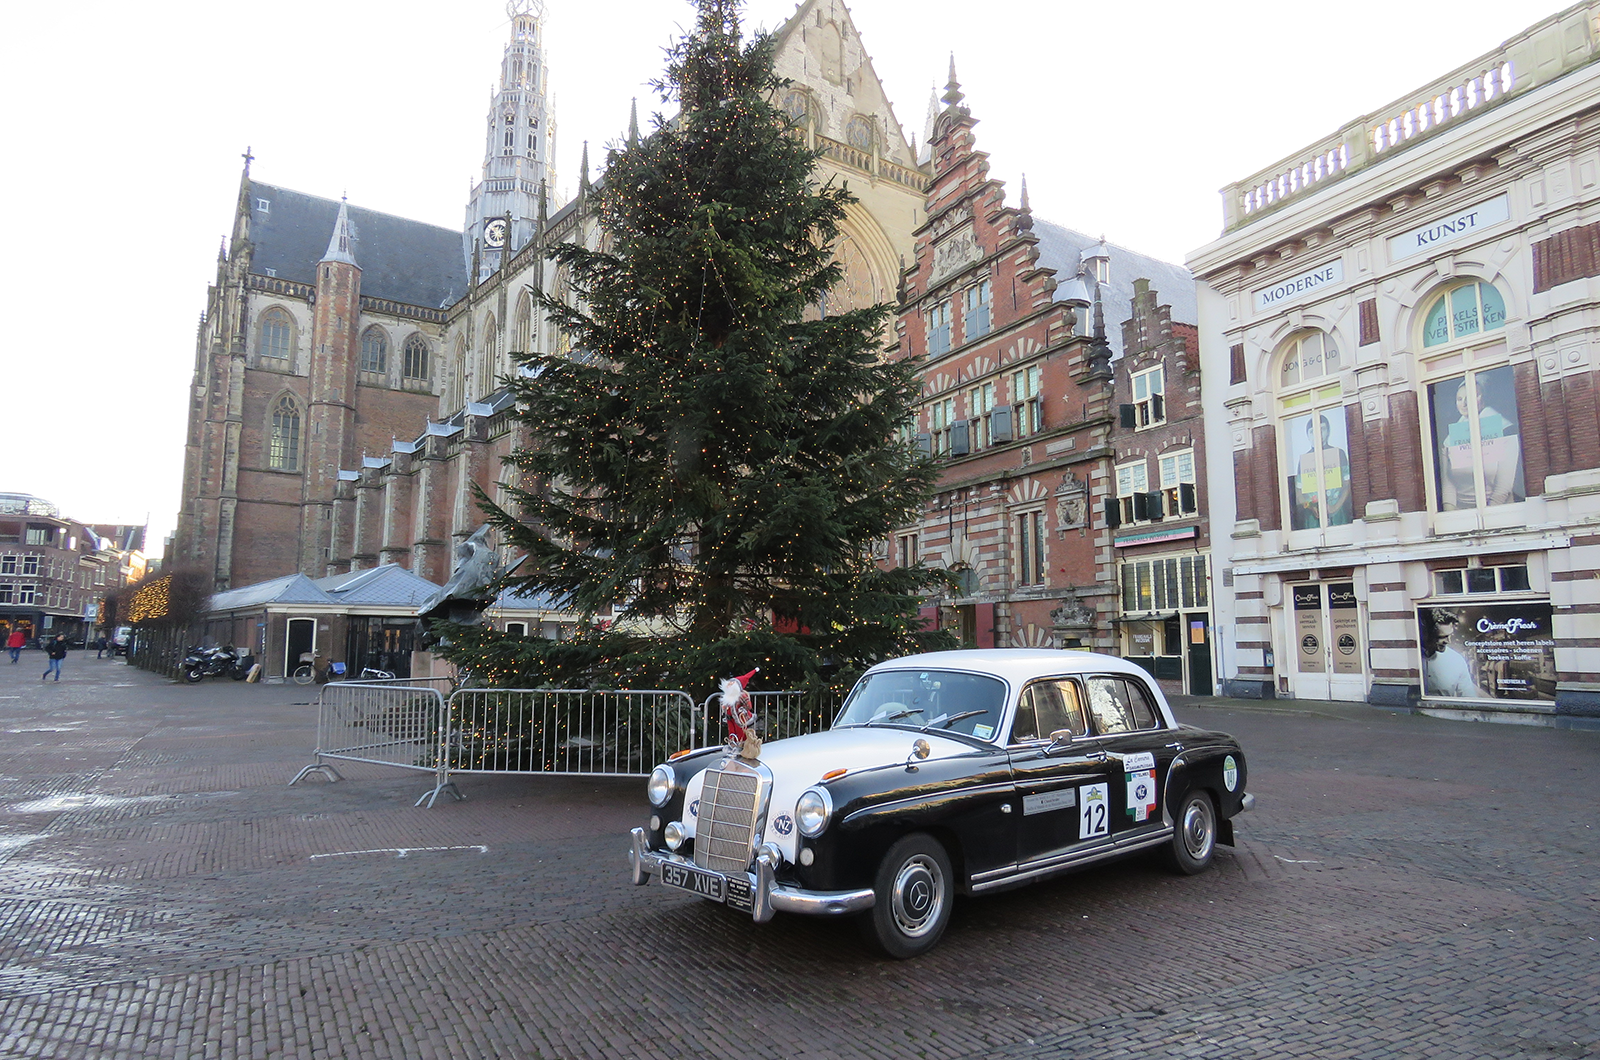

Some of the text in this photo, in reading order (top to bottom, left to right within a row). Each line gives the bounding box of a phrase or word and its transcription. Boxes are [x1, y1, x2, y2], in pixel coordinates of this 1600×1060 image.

[1416, 212, 1478, 247] KUNST
[1262, 267, 1334, 305] MODERNE
[1484, 303, 1492, 313] &
[778, 818, 790, 832] NZ
[1084, 803, 1106, 835] 12
[665, 865, 688, 887] 357
[693, 872, 719, 896] XVE
